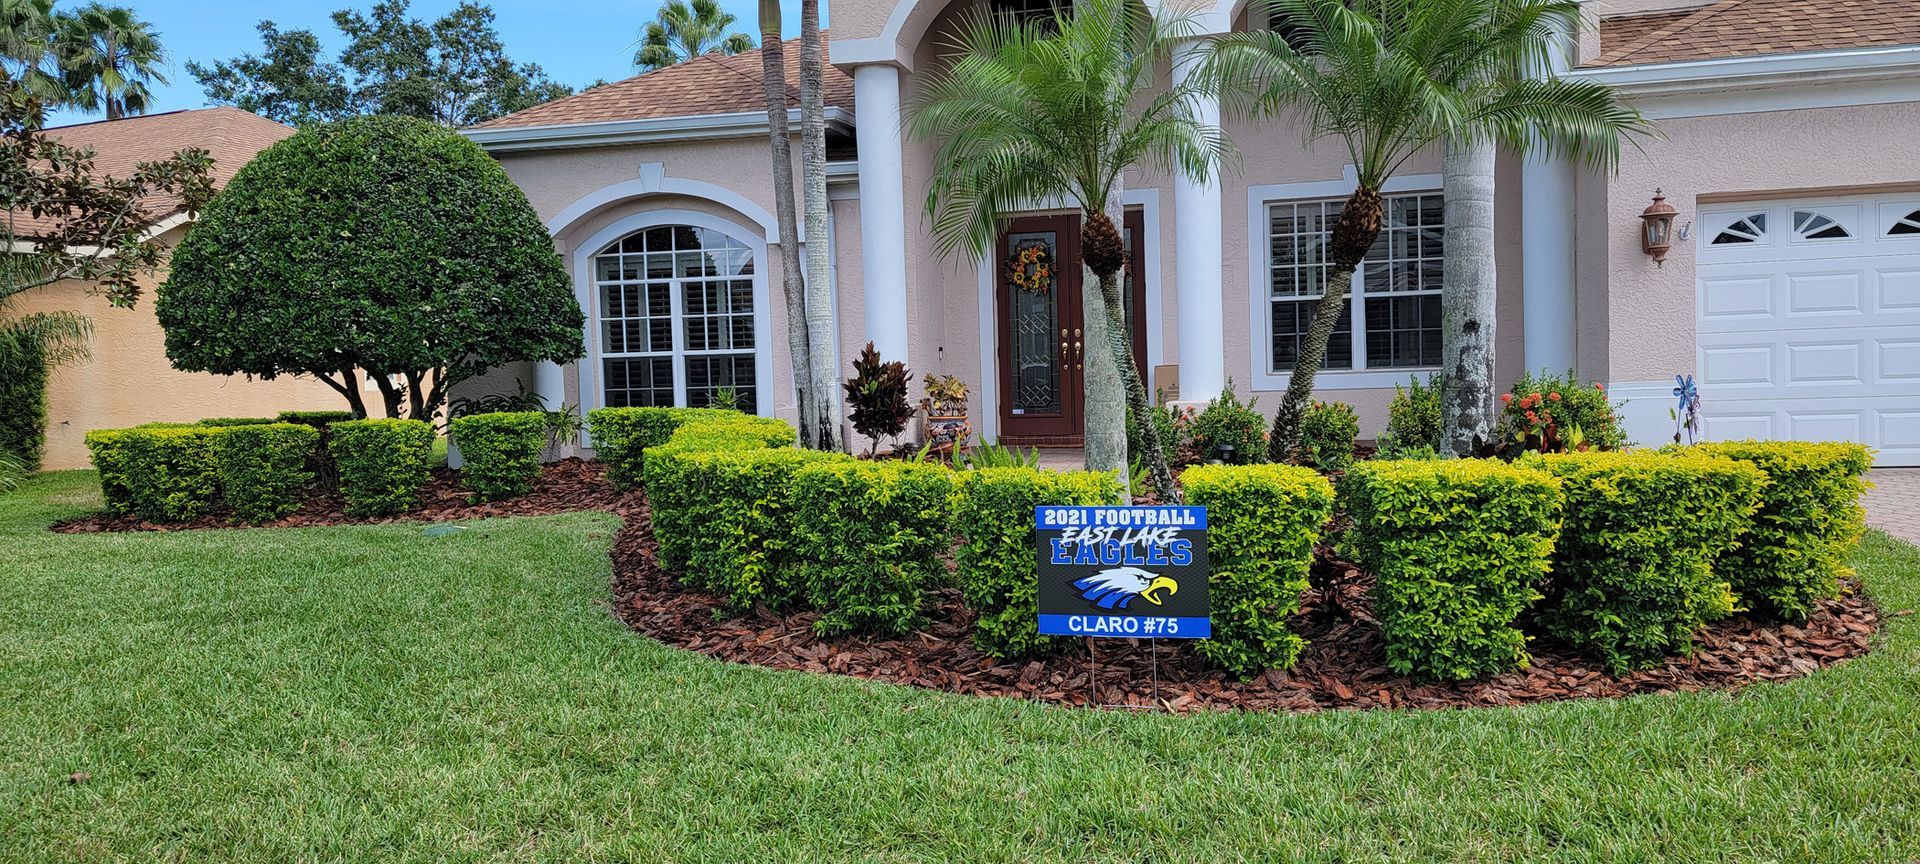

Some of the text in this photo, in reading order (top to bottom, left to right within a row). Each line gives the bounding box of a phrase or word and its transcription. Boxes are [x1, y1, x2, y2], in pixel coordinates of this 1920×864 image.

[1045, 509, 1195, 525] 2021 FOOTBALL
[1061, 525, 1181, 549] EAST LAKE
[1050, 538, 1193, 565] EAGLES
[1068, 616, 1178, 634] CLARO #75
